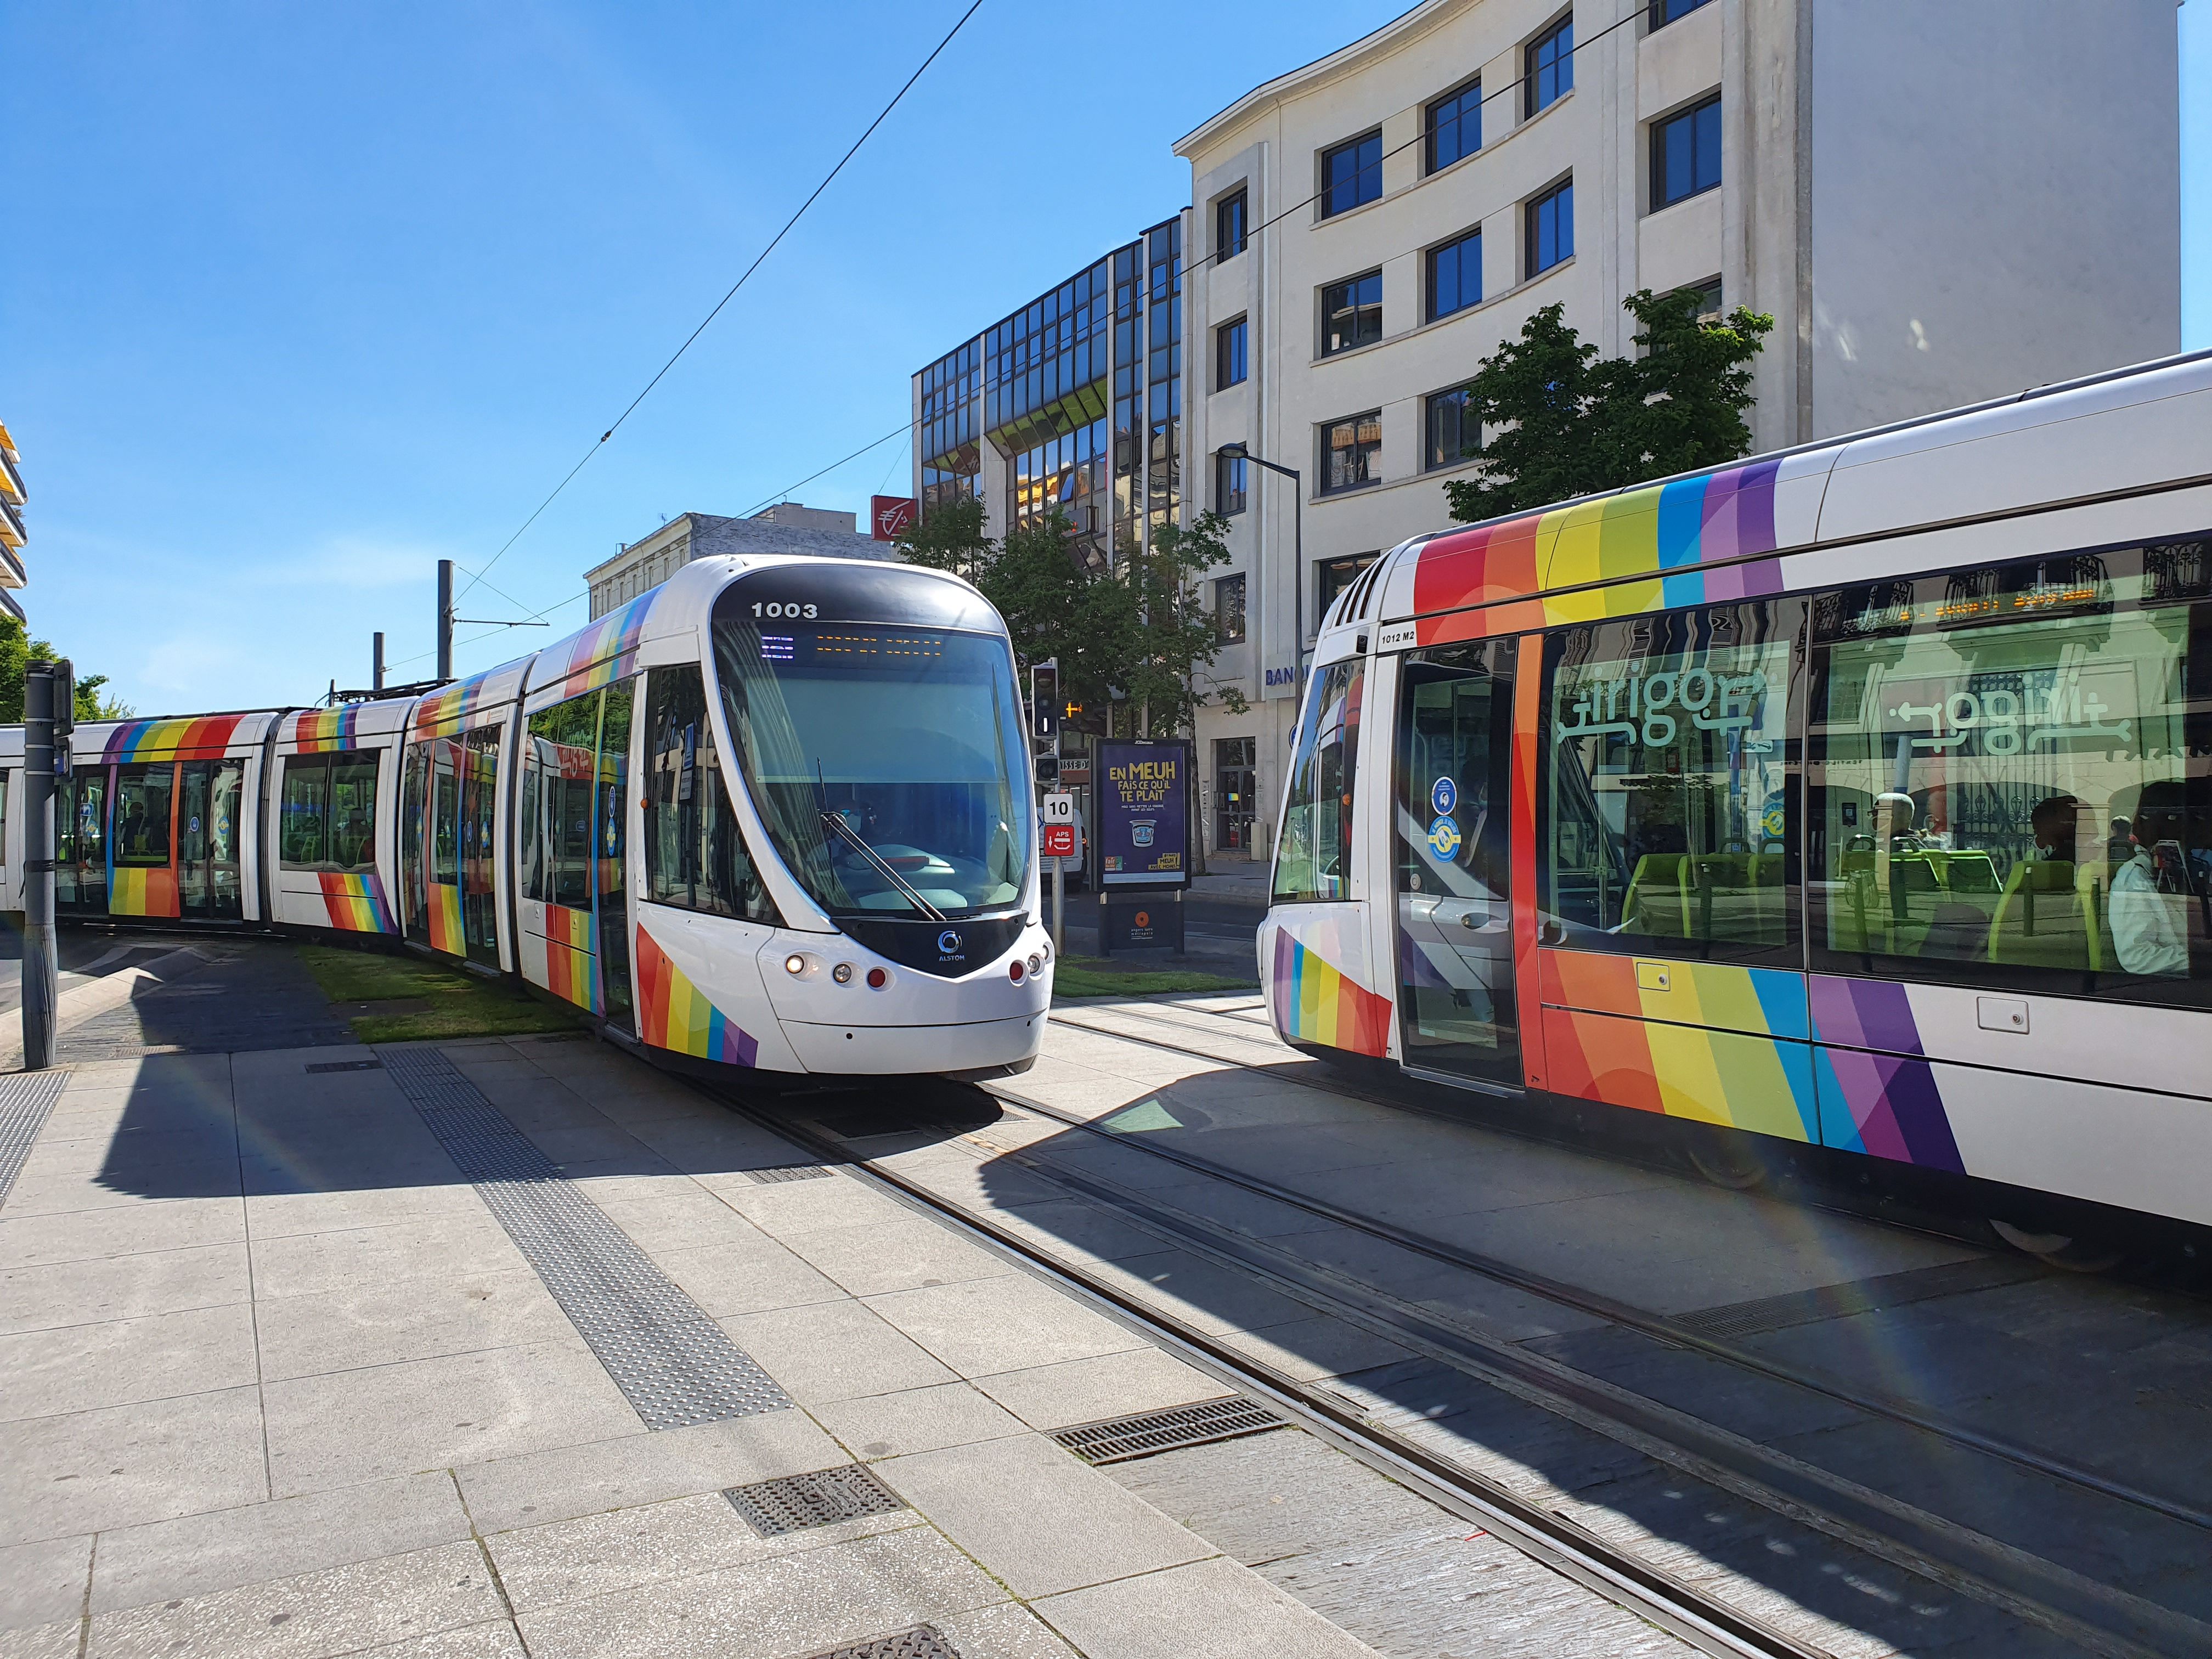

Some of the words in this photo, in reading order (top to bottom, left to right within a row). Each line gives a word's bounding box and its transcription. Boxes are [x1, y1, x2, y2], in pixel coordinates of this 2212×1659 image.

[752, 602, 818, 619] 1003
[1382, 633, 1401, 644] 1012
[1402, 631, 1414, 641] M2
[1109, 767, 1126, 780] EN
[1129, 761, 1175, 780] MEUH
[1138, 781, 1149, 790] CE
[1120, 791, 1134, 802] TE
[1049, 802, 1069, 816] 10
